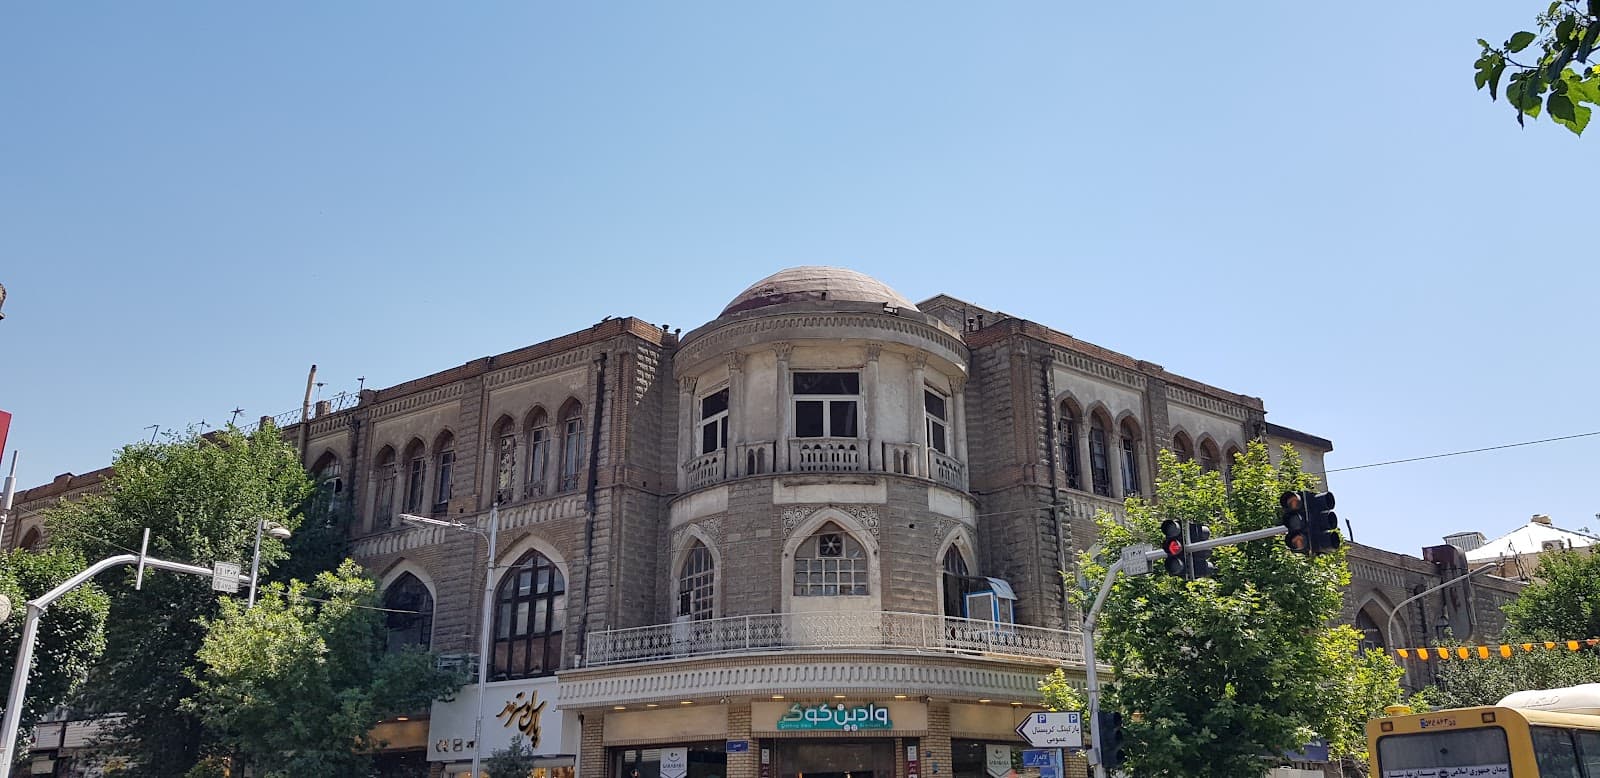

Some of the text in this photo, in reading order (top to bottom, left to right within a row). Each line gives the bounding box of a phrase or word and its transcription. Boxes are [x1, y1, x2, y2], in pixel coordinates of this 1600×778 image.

[1032, 725, 1079, 735] پارکینگ کریستال
[1046, 737, 1066, 745] عمومی
[1450, 767, 1468, 777] اسلامی
[1469, 768, 1490, 776] جمهوری
[1491, 766, 1508, 775] میدان
